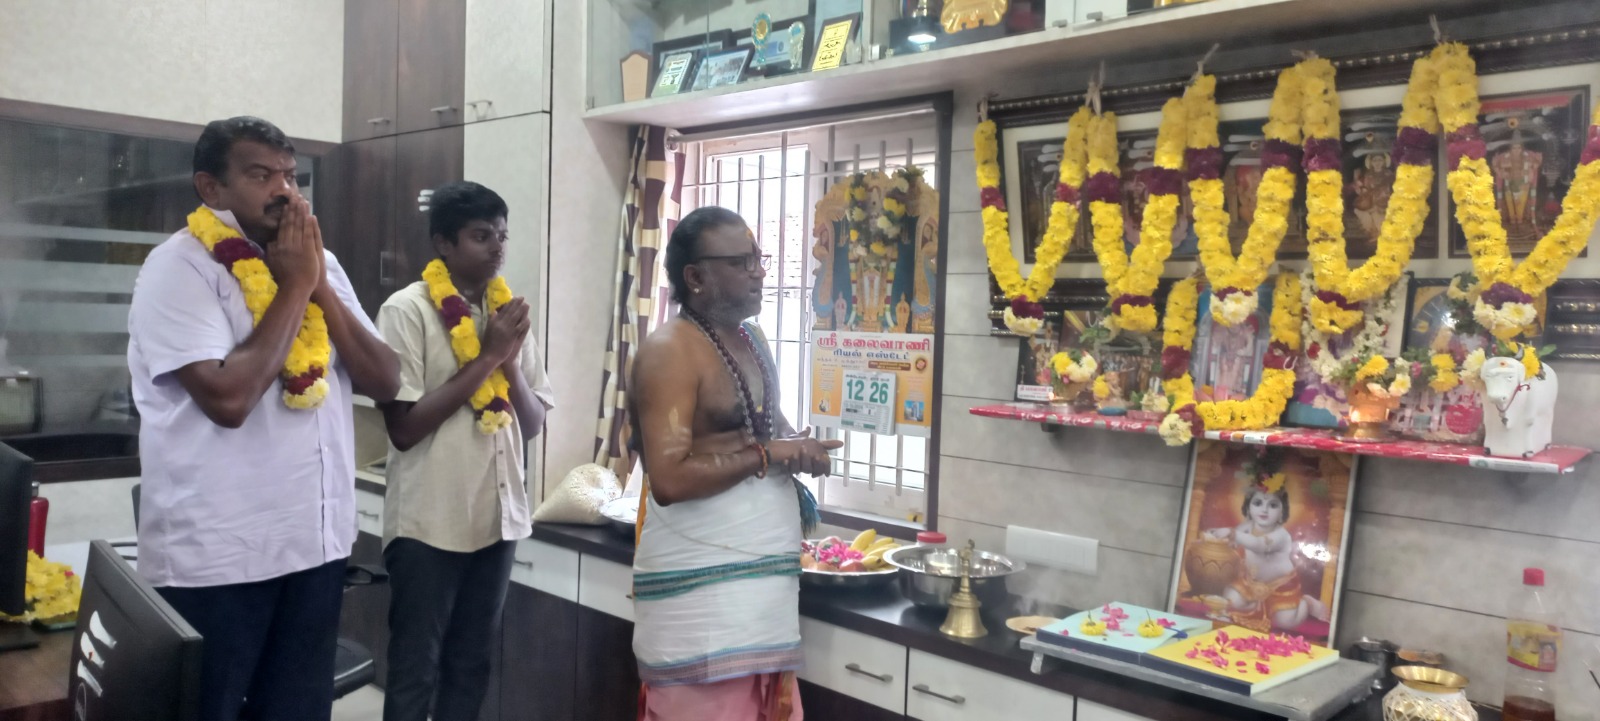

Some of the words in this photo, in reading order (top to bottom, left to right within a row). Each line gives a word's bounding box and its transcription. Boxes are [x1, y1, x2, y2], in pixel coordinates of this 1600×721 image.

[842, 338, 930, 351] கலைவாணி
[833, 348, 863, 357] ரியல்
[866, 351, 910, 360] எஸ்டேட்
[846, 379, 865, 401] 12
[869, 381, 889, 405] 26
